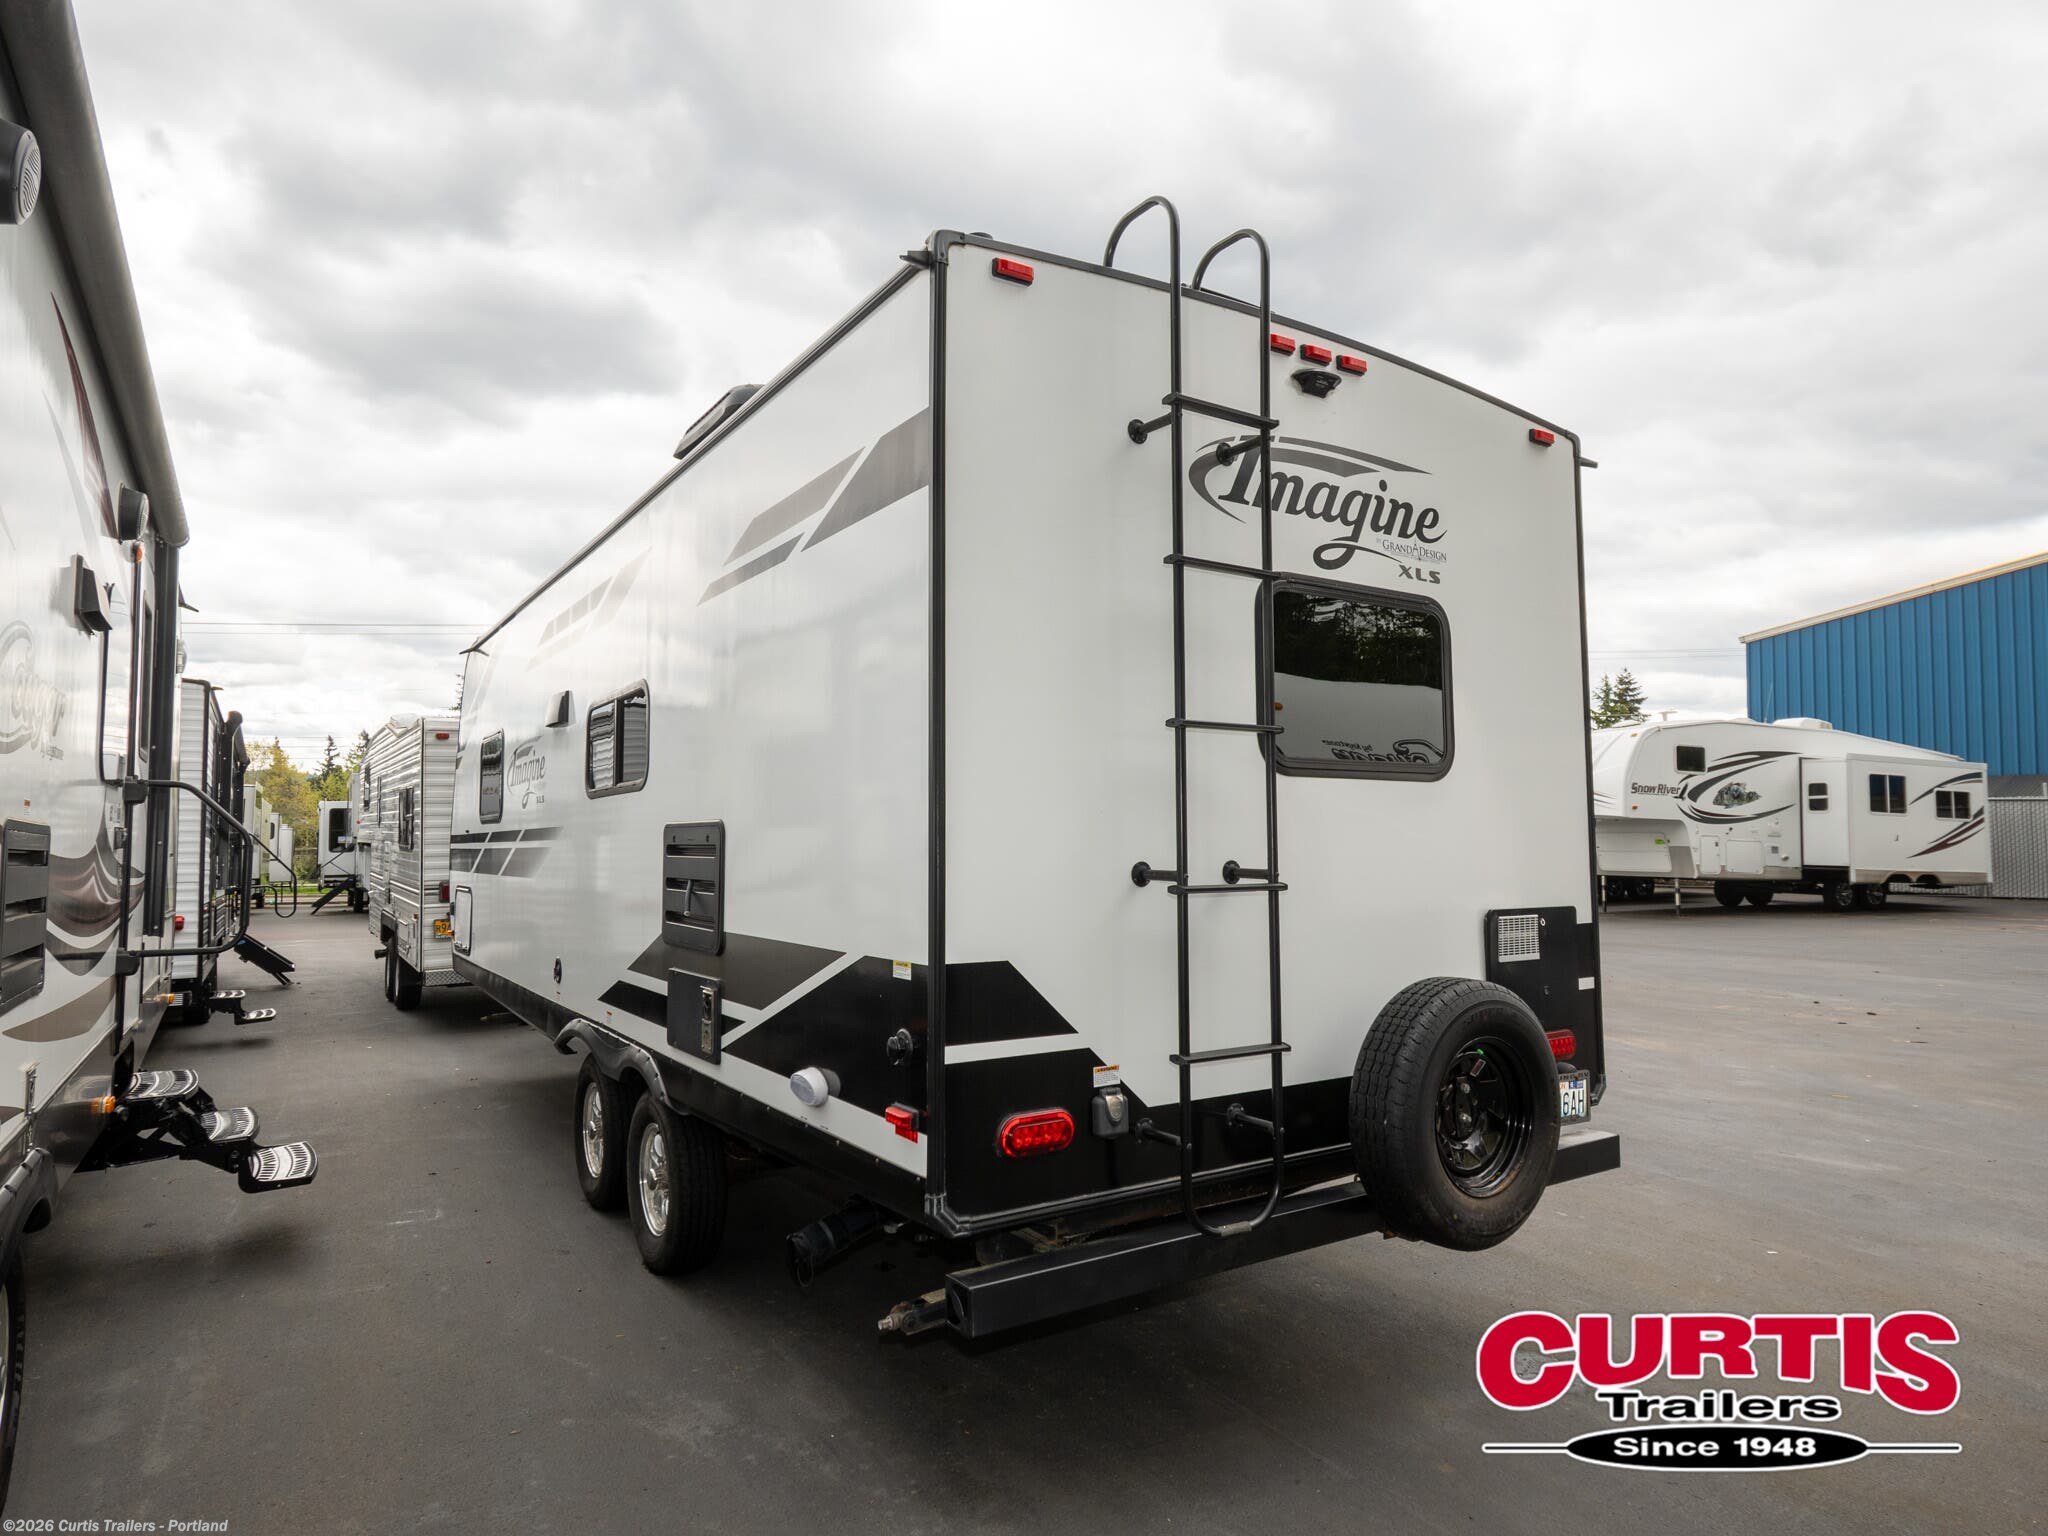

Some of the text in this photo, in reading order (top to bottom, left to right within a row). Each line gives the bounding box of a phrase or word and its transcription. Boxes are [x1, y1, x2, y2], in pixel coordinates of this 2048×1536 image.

[1218, 446, 1448, 570] Imagine
[1398, 564, 1441, 584] XLS
[510, 748, 546, 809] Imagine
[1631, 782, 1681, 795] Snow River
